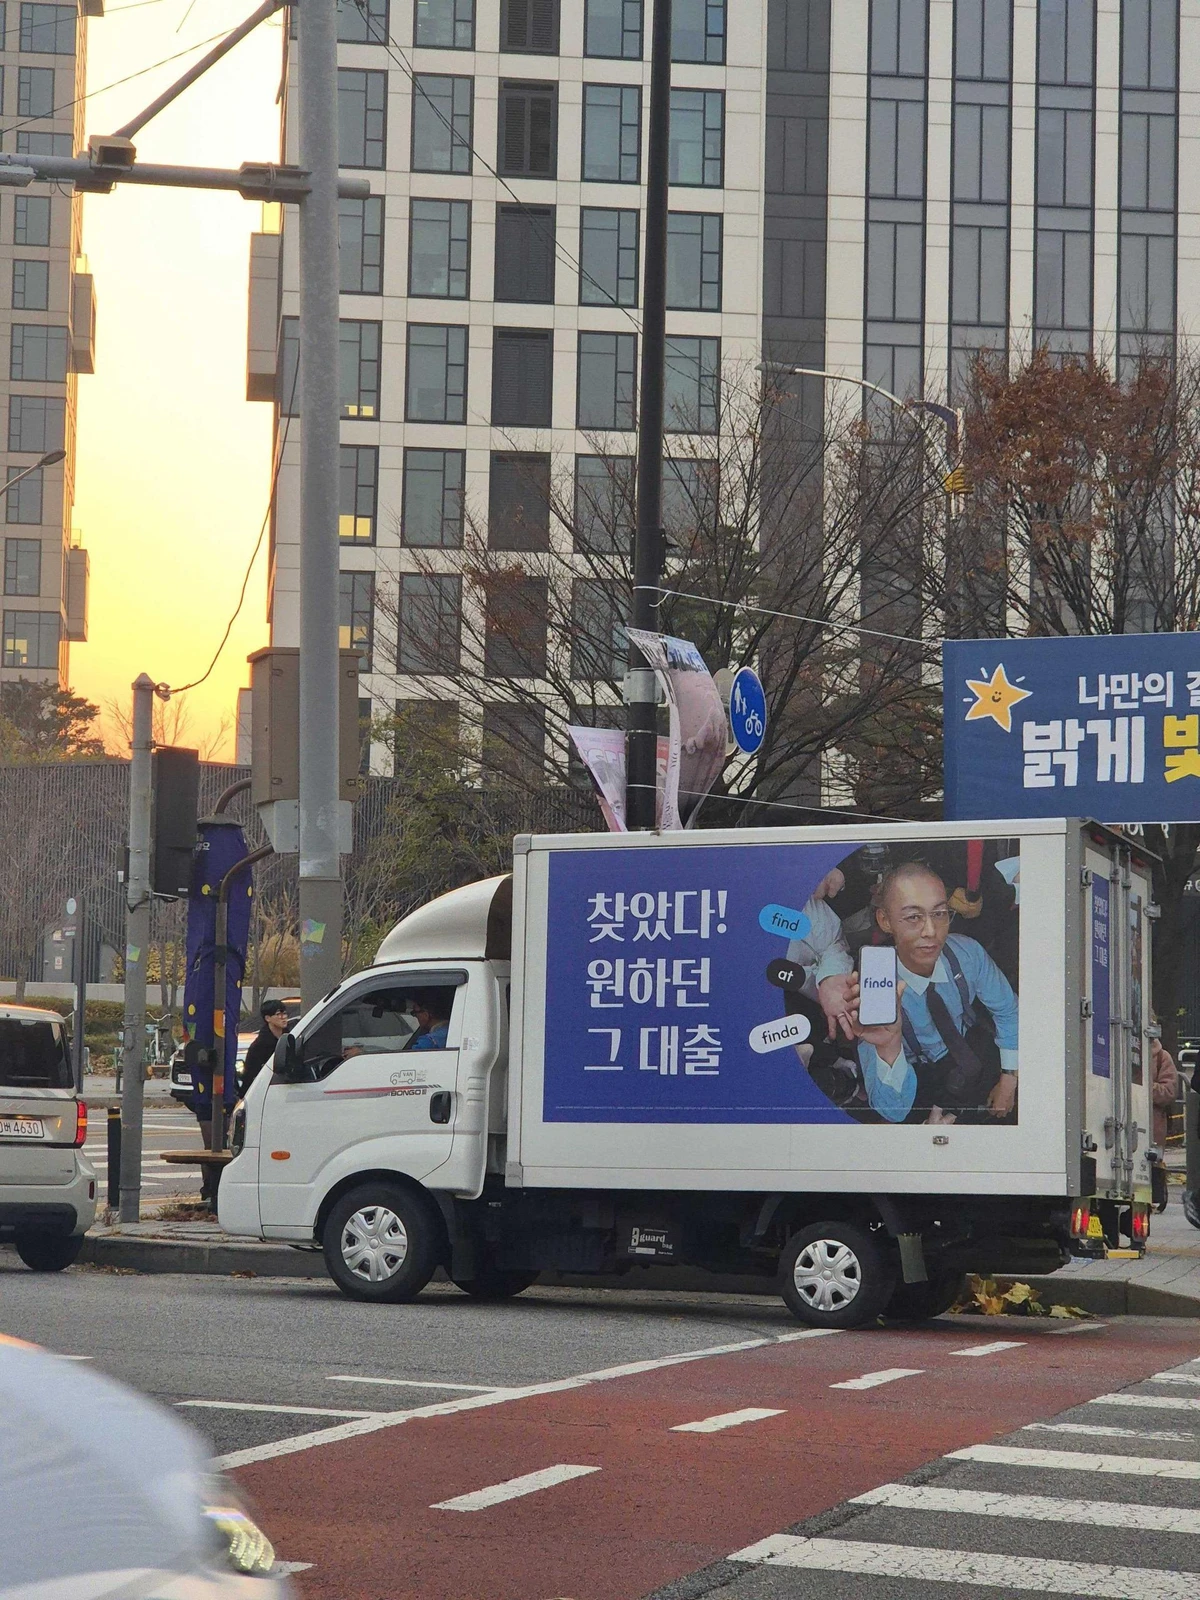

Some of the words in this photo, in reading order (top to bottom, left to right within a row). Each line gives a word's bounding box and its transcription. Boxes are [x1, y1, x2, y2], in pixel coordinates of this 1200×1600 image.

[1078, 671, 1174, 710] 나만의
[1022, 715, 1145, 788] 밝게
[586, 889, 728, 943] 찾았다!
[771, 912, 800, 932] find
[585, 957, 711, 1008] 원하던
[777, 970, 794, 983] at
[863, 977, 894, 988] finda
[583, 1028, 624, 1071] 그
[639, 1024, 723, 1075] 대출
[761, 1024, 799, 1045] finda
[13, 1121, 39, 1135] 4630
